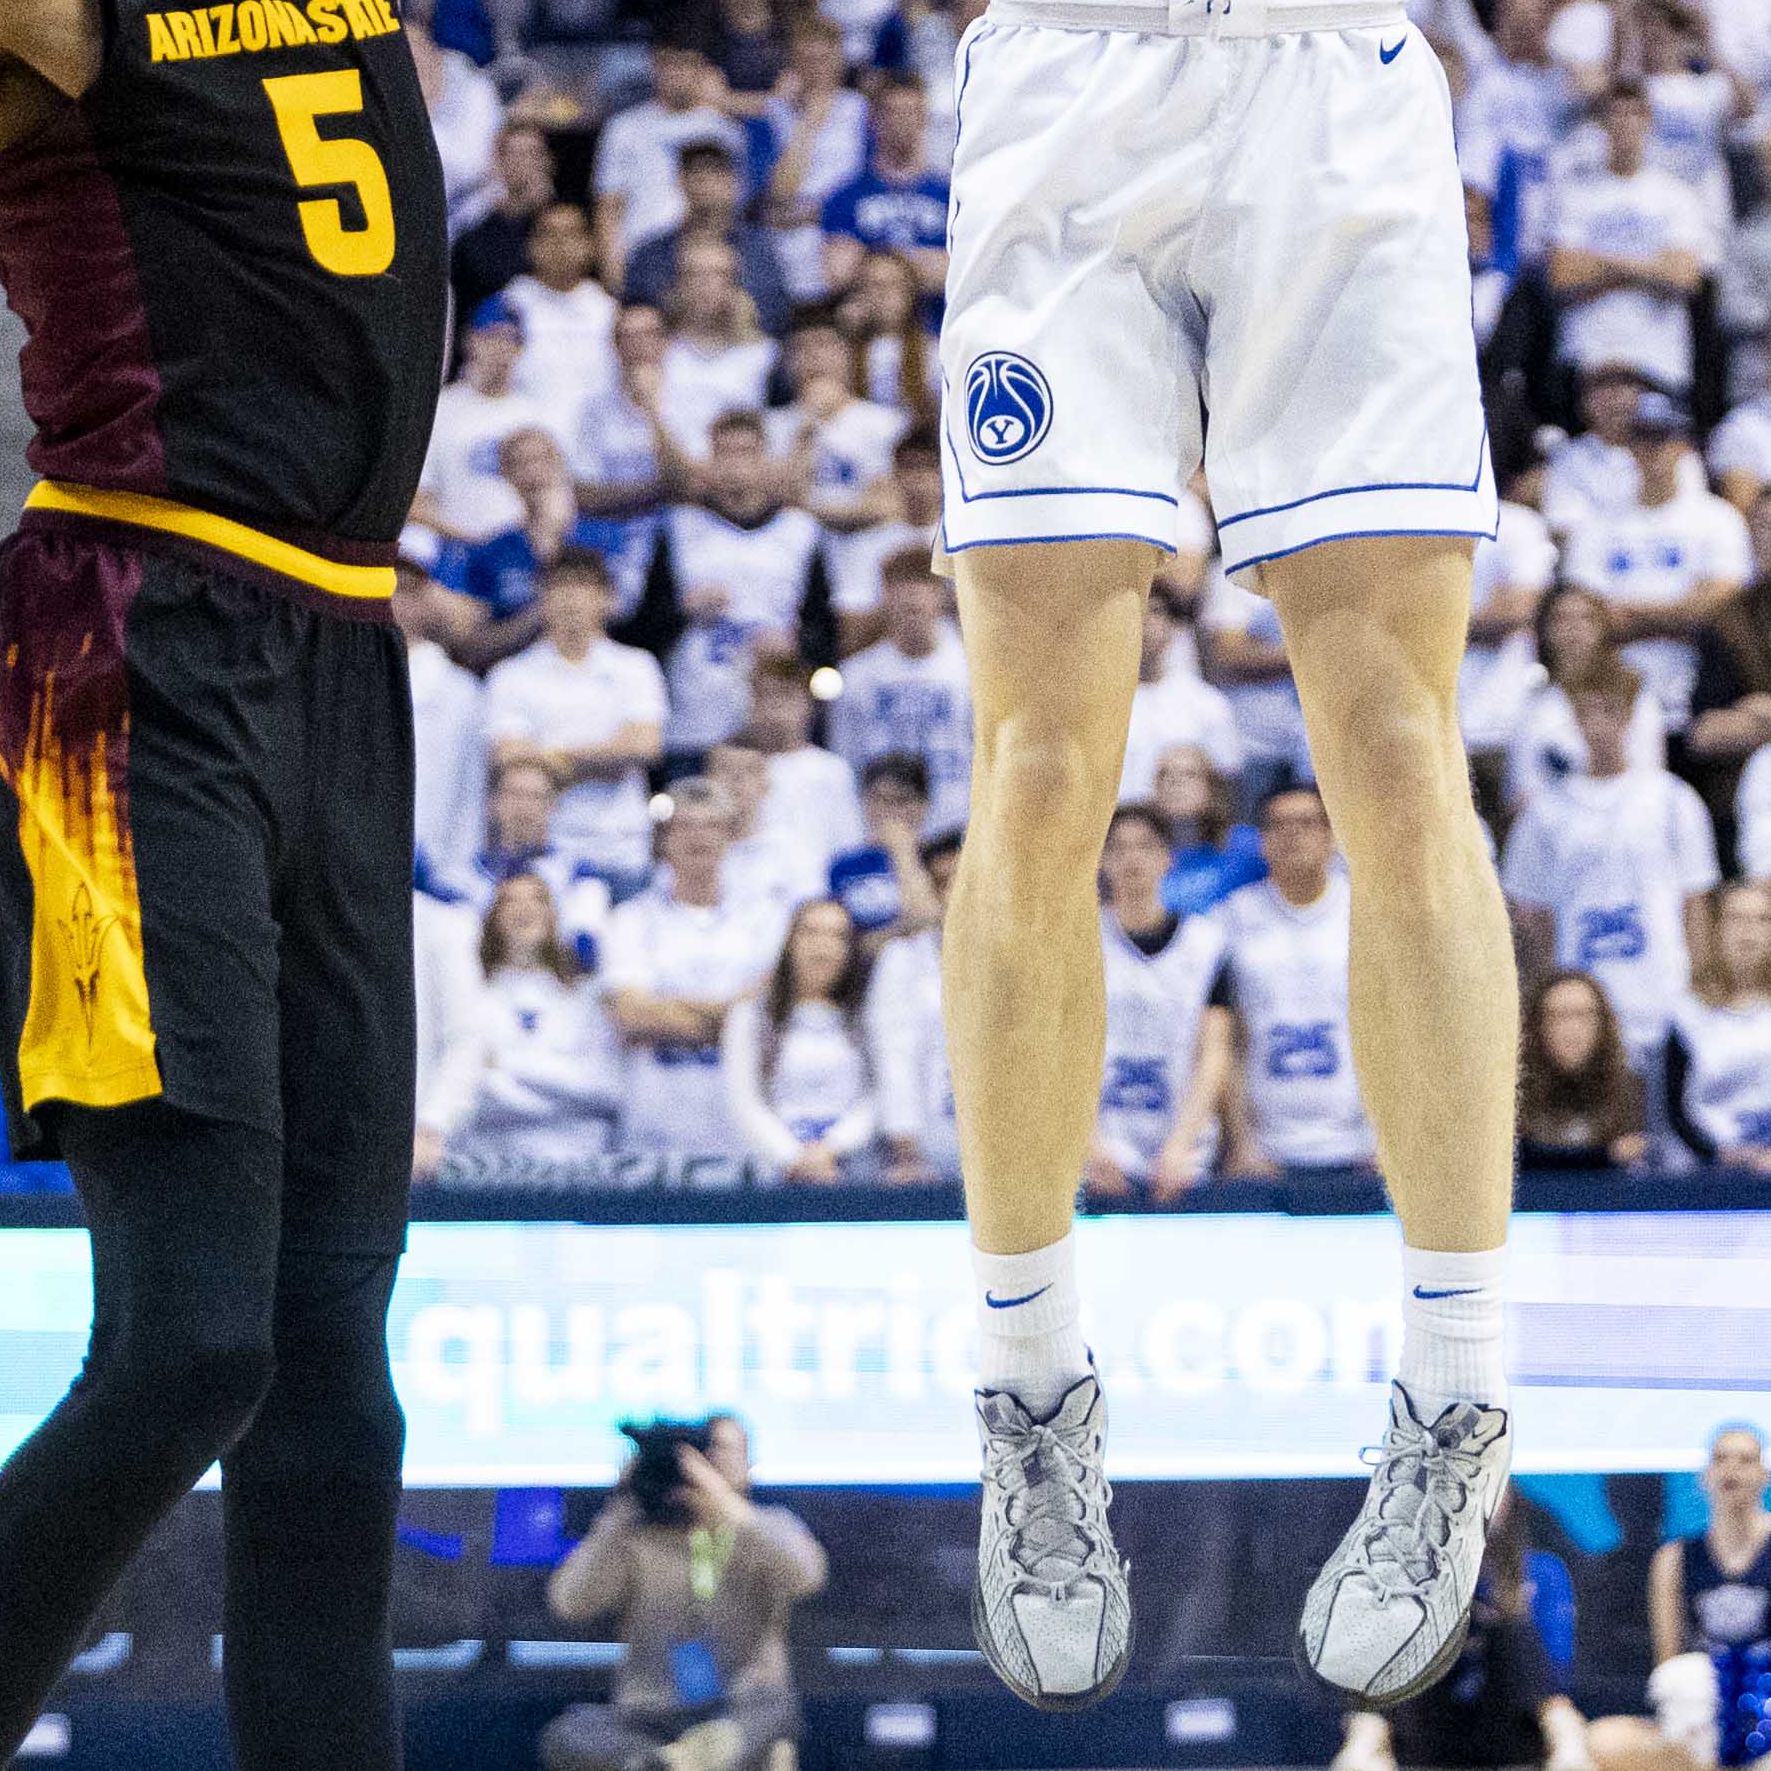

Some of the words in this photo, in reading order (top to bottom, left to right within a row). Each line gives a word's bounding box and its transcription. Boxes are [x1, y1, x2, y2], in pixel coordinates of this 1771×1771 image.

[262, 68, 396, 277] 5
[986, 419, 1014, 446] Y
[405, 1265, 1402, 1436] qualtric.com
